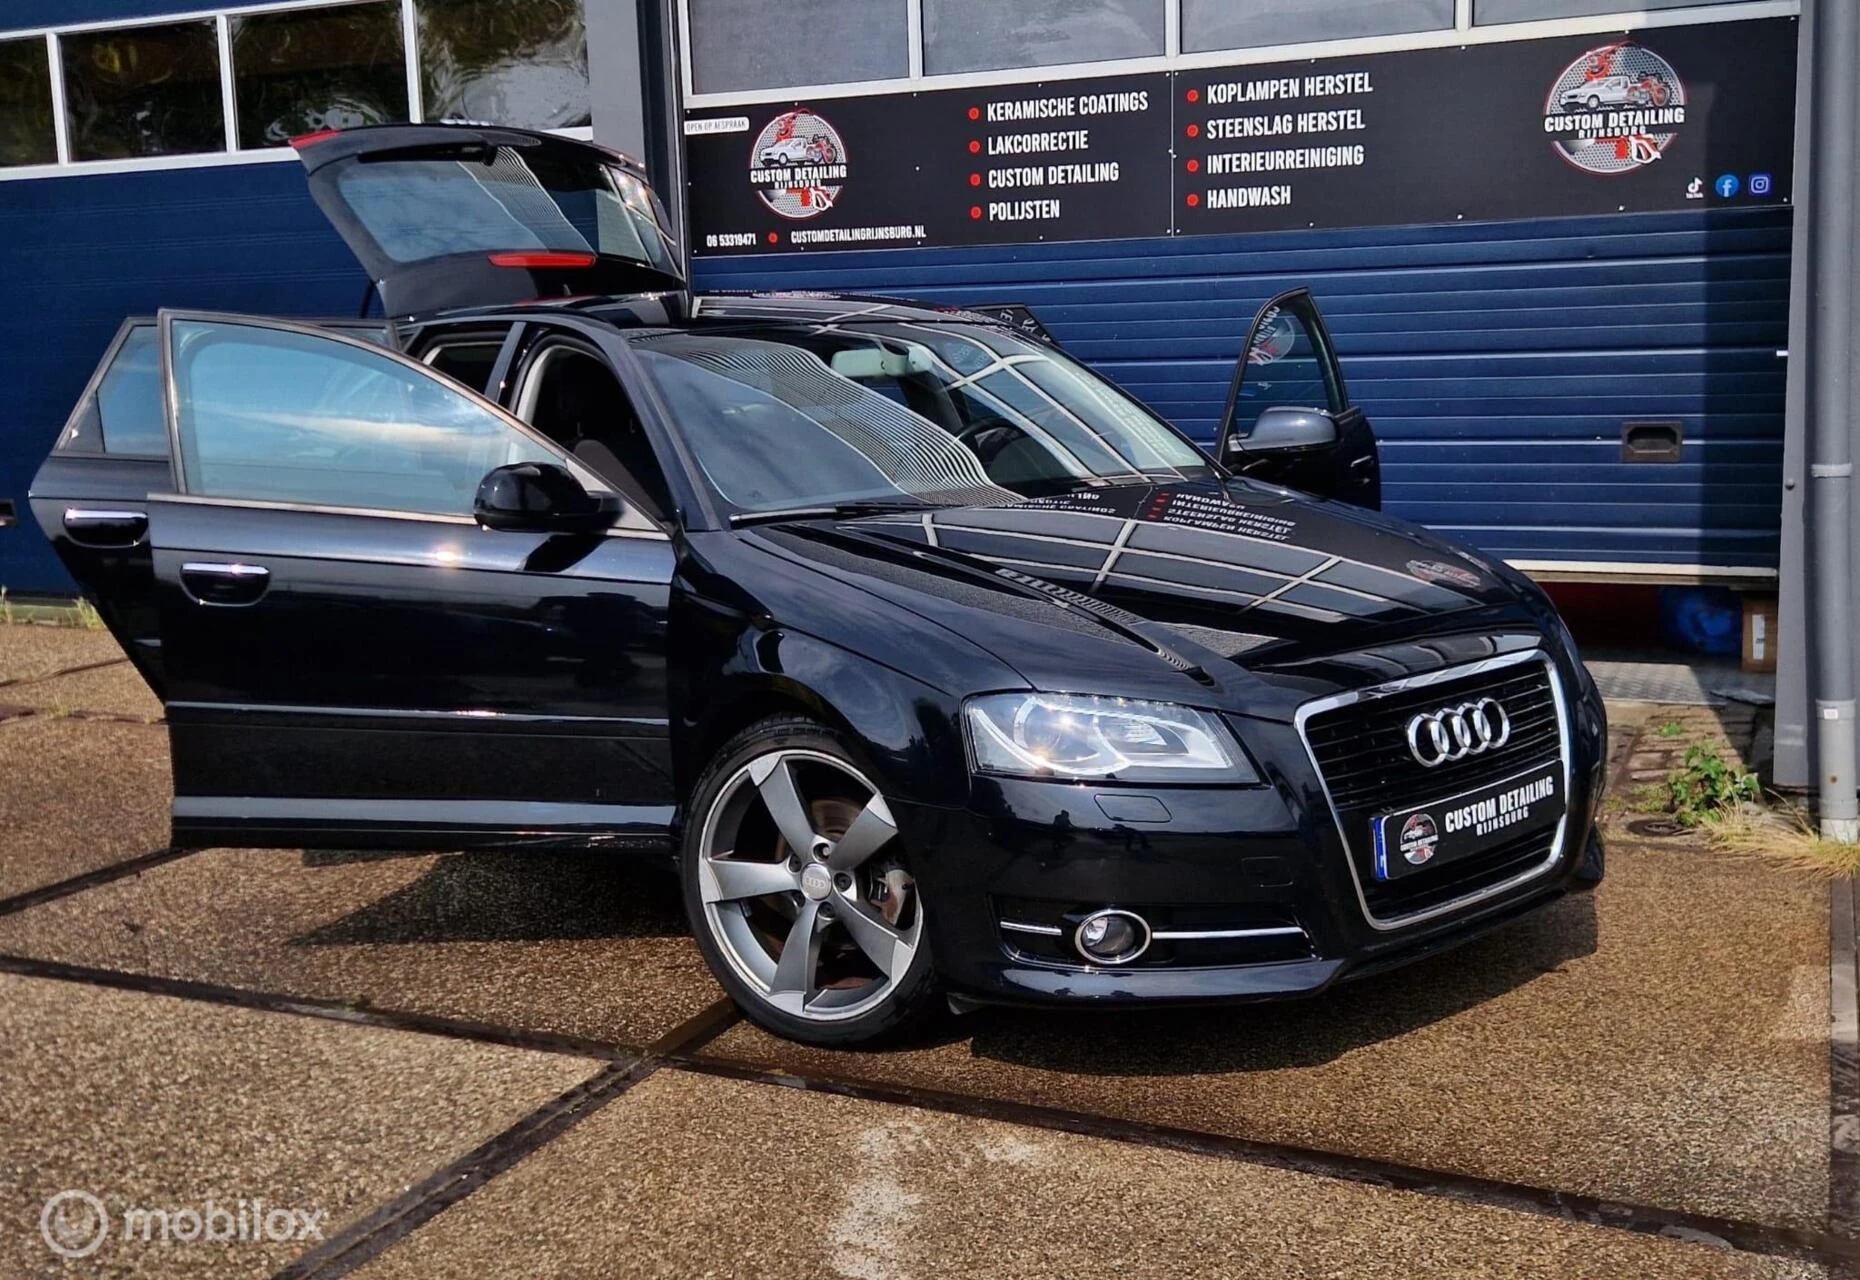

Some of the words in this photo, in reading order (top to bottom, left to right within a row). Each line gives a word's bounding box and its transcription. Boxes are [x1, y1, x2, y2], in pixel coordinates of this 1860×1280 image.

[1207, 78, 1300, 104] KOPLAMPEN
[1304, 72, 1373, 97] HERSTEL
[987, 97, 1076, 122] KERAMISCHE
[1079, 91, 1149, 115] COATINGS
[686, 123, 703, 131] OPEN
[704, 122, 713, 130] OP
[1207, 114, 1293, 139] STEENSLAG
[1297, 109, 1366, 133] HERSTEL
[1544, 114, 1603, 132] CUSTOM
[1608, 107, 1685, 128] DETAILING
[988, 130, 1089, 155] LAKCORRECTIE
[1578, 126, 1647, 139] RIJNSBURG
[1207, 145, 1365, 174] INTERIEURREINIGING
[750, 169, 791, 183] CUSTOM
[795, 165, 847, 180] DETAILING
[988, 167, 1044, 188] CUSTOM
[1048, 162, 1120, 185] DETAILING
[1207, 185, 1291, 209] HANDWASH
[989, 200, 1060, 221] POLIJSTEN
[706, 235, 717, 247] 06
[719, 233, 756, 246] 53319471
[791, 225, 927, 244] CUSTOMDETAILINGRIJNSBURG.NL
[1445, 803, 1496, 833] CUSTOM
[1499, 776, 1554, 812] DETAILING
[1476, 806, 1529, 836] RIJNSBURG
